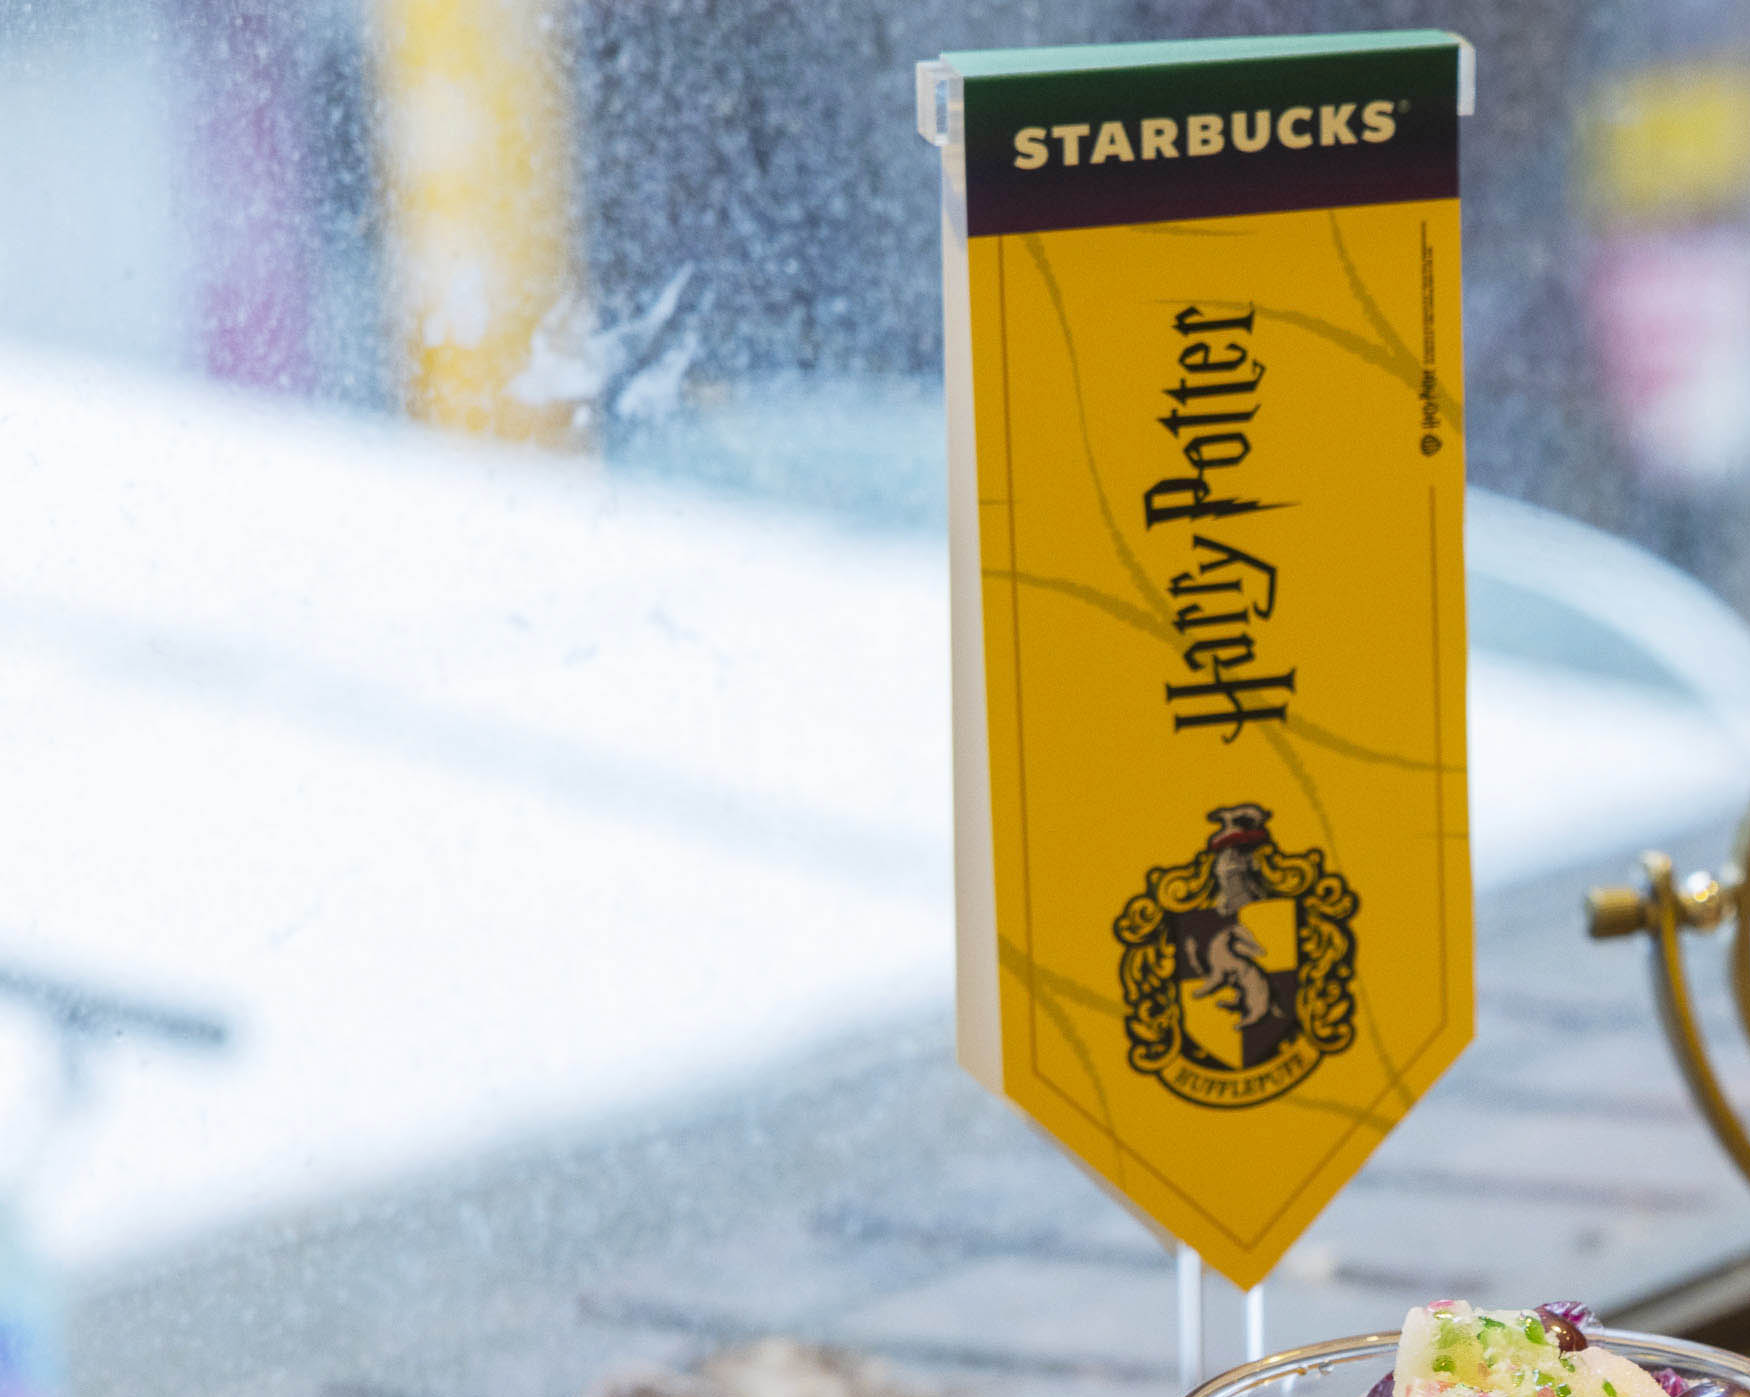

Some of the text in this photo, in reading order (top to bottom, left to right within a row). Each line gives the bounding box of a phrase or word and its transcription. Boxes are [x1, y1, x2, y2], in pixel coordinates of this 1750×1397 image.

[1014, 100, 1397, 170] STARBUCKS
[1143, 300, 1302, 745] Harry Potter
